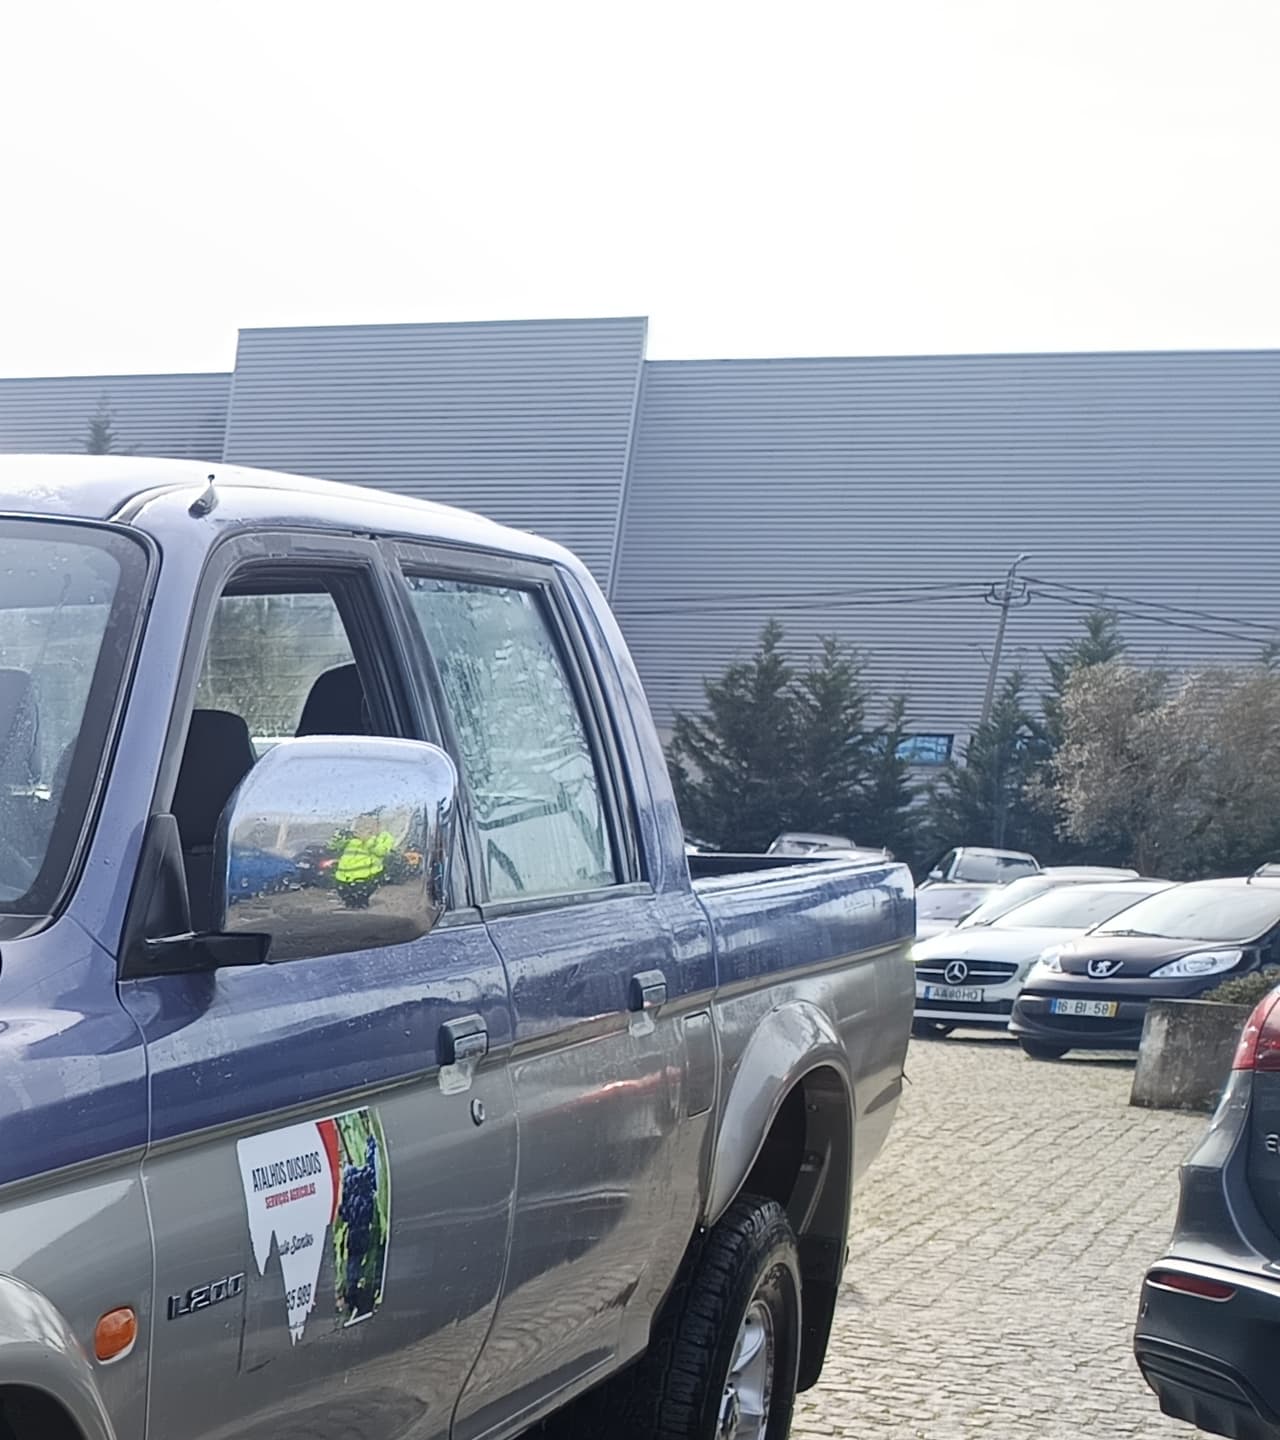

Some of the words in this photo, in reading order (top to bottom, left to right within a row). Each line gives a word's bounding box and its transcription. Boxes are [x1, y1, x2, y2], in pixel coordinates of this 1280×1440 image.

[251, 1161, 288, 1193] ATALHOS
[286, 1151, 322, 1182] OUSADOS
[167, 1272, 245, 1321] L200
